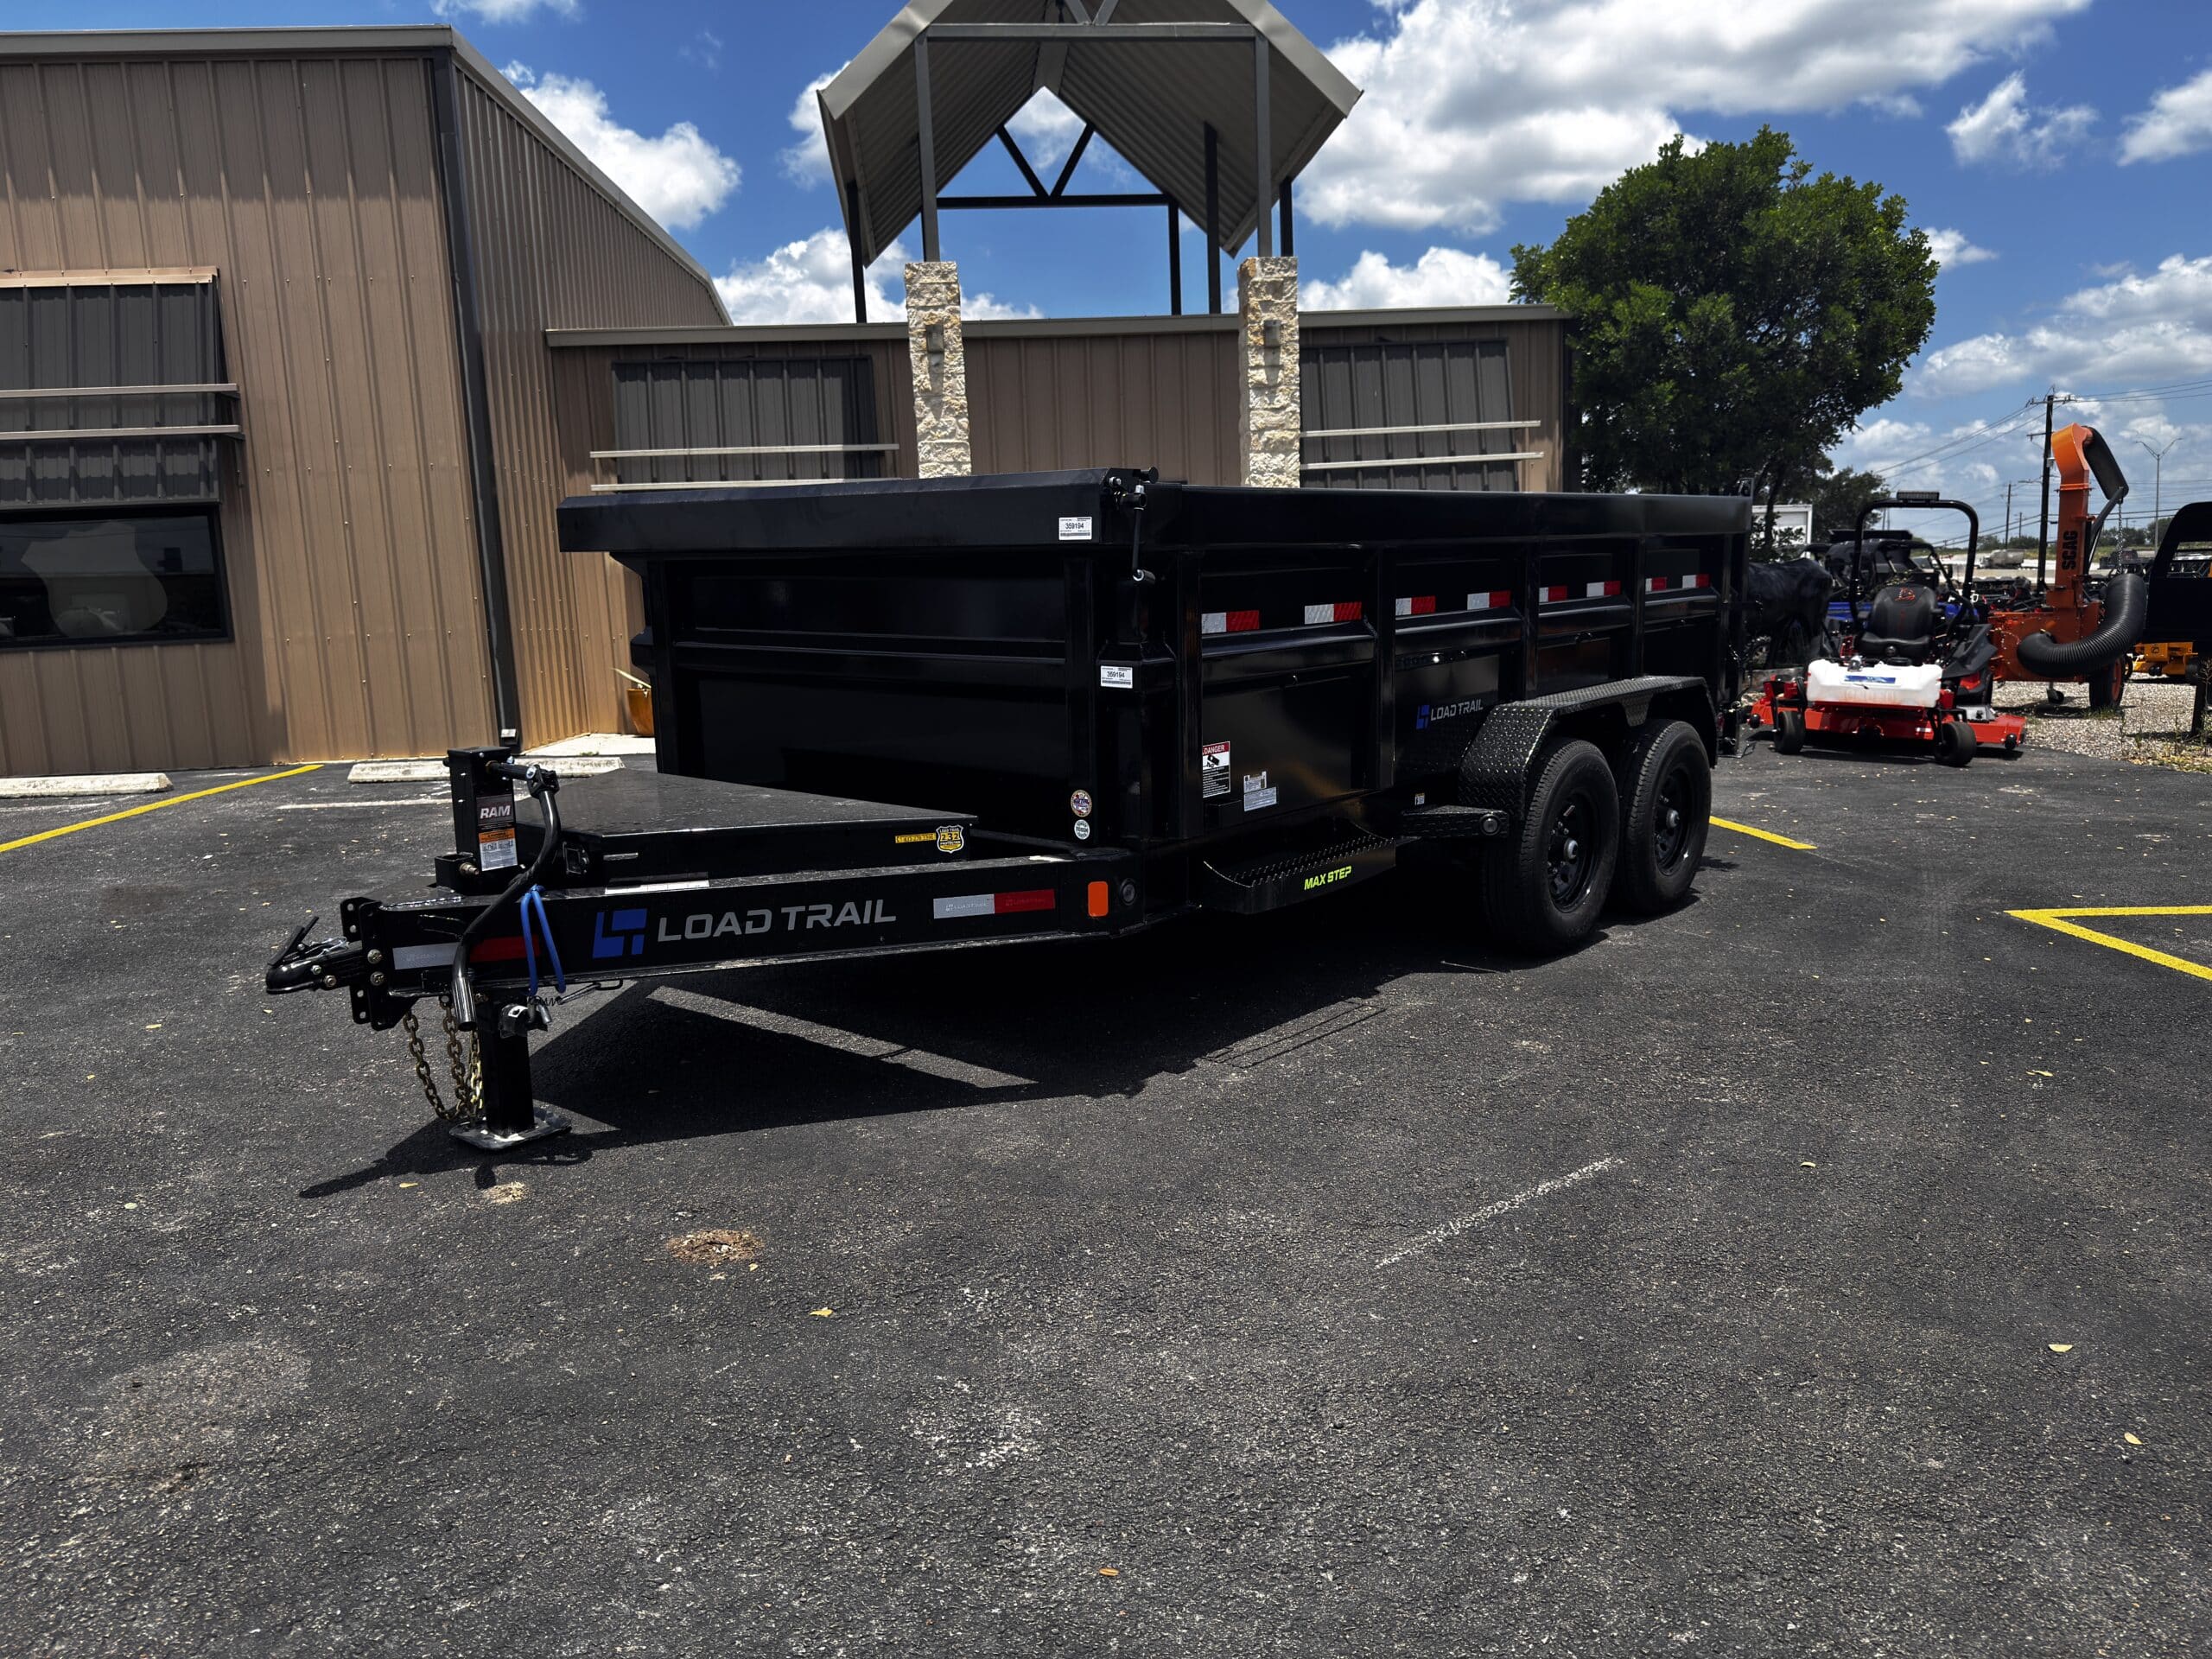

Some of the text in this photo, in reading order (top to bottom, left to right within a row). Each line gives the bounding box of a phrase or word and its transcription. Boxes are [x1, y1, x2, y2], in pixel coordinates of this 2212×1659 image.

[2061, 530, 2079, 570] SCAG
[1430, 698, 1484, 721] LOAD TRAIL
[1204, 744, 1225, 755] DANGER
[480, 805, 511, 819] RAM
[1303, 865, 1352, 891] MAX STEP
[658, 899, 897, 942] LOAD TRAIL
